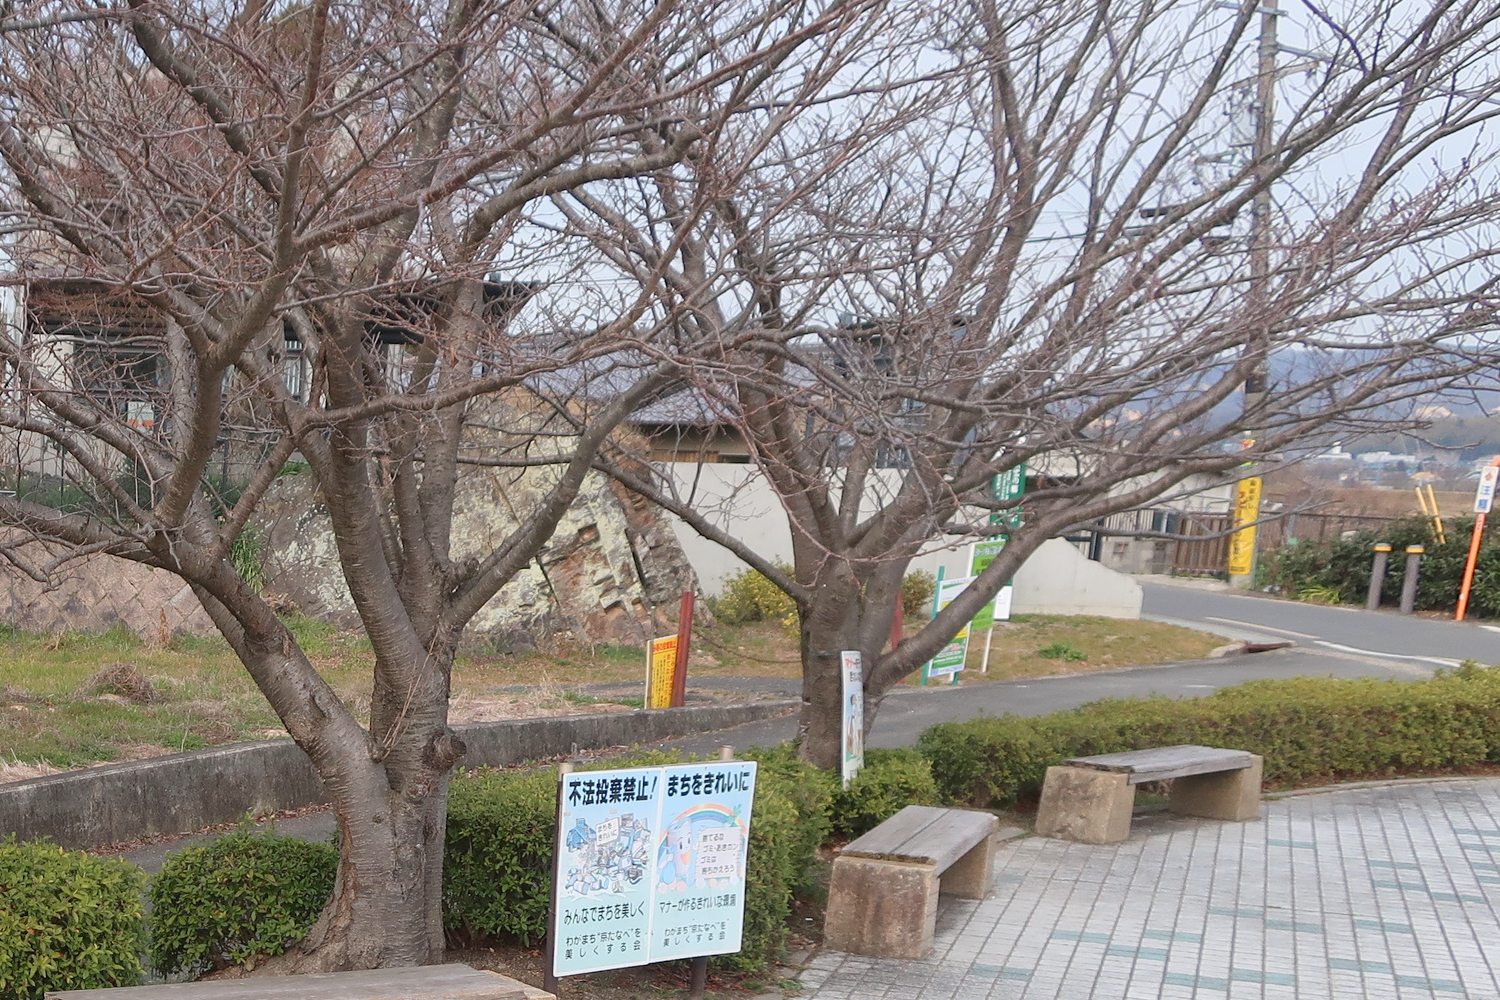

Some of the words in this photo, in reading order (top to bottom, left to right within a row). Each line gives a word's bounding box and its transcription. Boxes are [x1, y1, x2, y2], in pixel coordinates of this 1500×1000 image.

[568, 775, 658, 807] 不法投棄禁止!
[667, 771, 750, 797] まちをきれいに
[563, 900, 645, 925] みんなでまちを美しく
